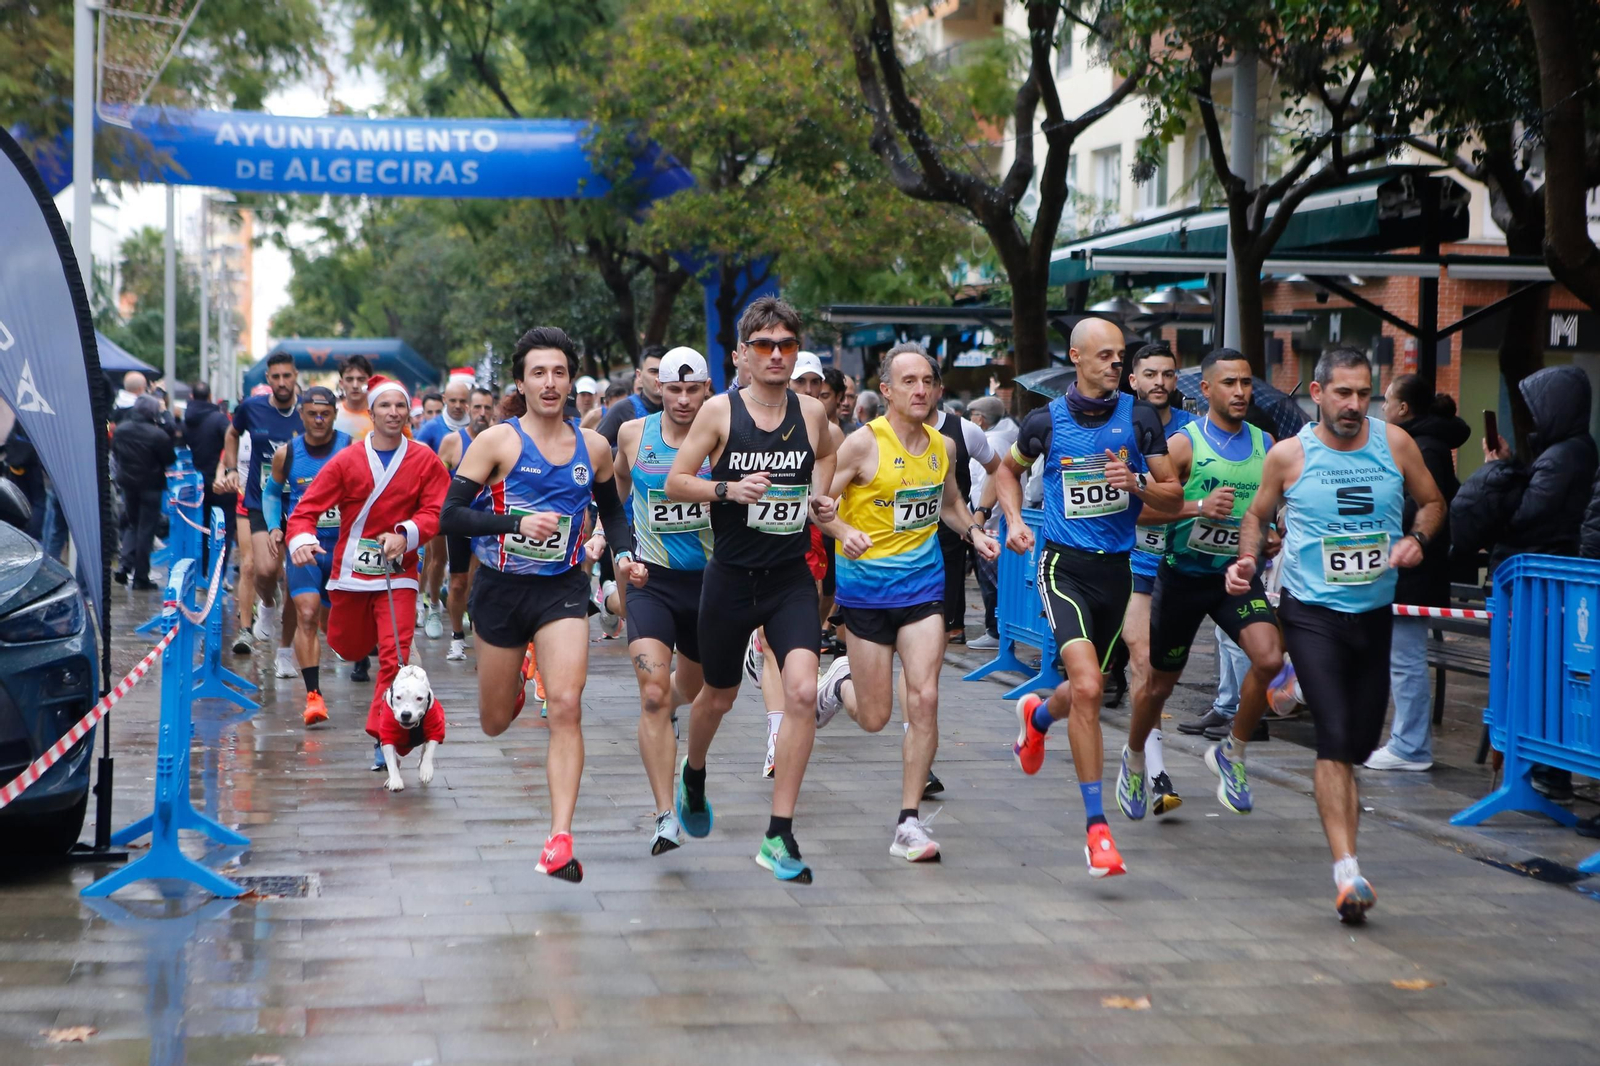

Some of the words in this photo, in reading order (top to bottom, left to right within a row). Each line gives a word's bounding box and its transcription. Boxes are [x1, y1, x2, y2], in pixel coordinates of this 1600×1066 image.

[214, 122, 499, 152] AYUNTAMIENTO
[235, 159, 275, 181] DE
[283, 157, 480, 185] ALGECIRAS
[520, 466, 542, 475] KAIXO
[1321, 468, 1354, 477] CARRERA
[1355, 466, 1387, 475] POPULAR
[1330, 475, 1384, 485] EMBARCADERO
[1069, 483, 1121, 505] 508
[654, 502, 703, 522] 214
[755, 501, 802, 522] 787
[900, 498, 939, 521] 706
[1198, 524, 1240, 546] 709
[1327, 519, 1386, 531] SEAT
[358, 551, 383, 566] 41
[1330, 549, 1382, 571] 612
